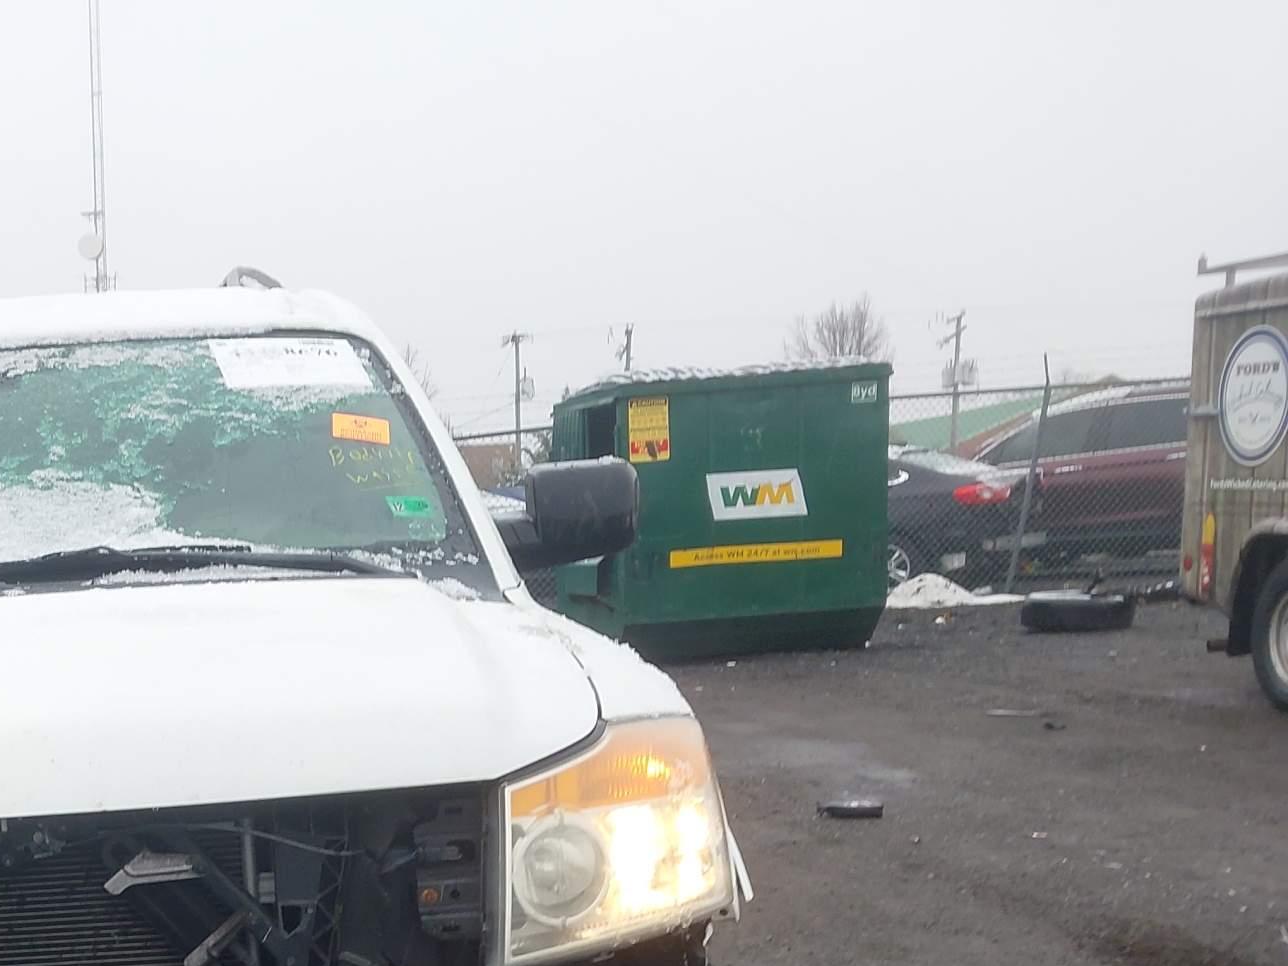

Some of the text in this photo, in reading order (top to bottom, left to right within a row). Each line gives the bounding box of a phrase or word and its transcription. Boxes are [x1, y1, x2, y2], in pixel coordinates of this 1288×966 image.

[720, 480, 795, 507] WM
[727, 550, 744, 560] WM
[747, 548, 769, 559] 24/7
